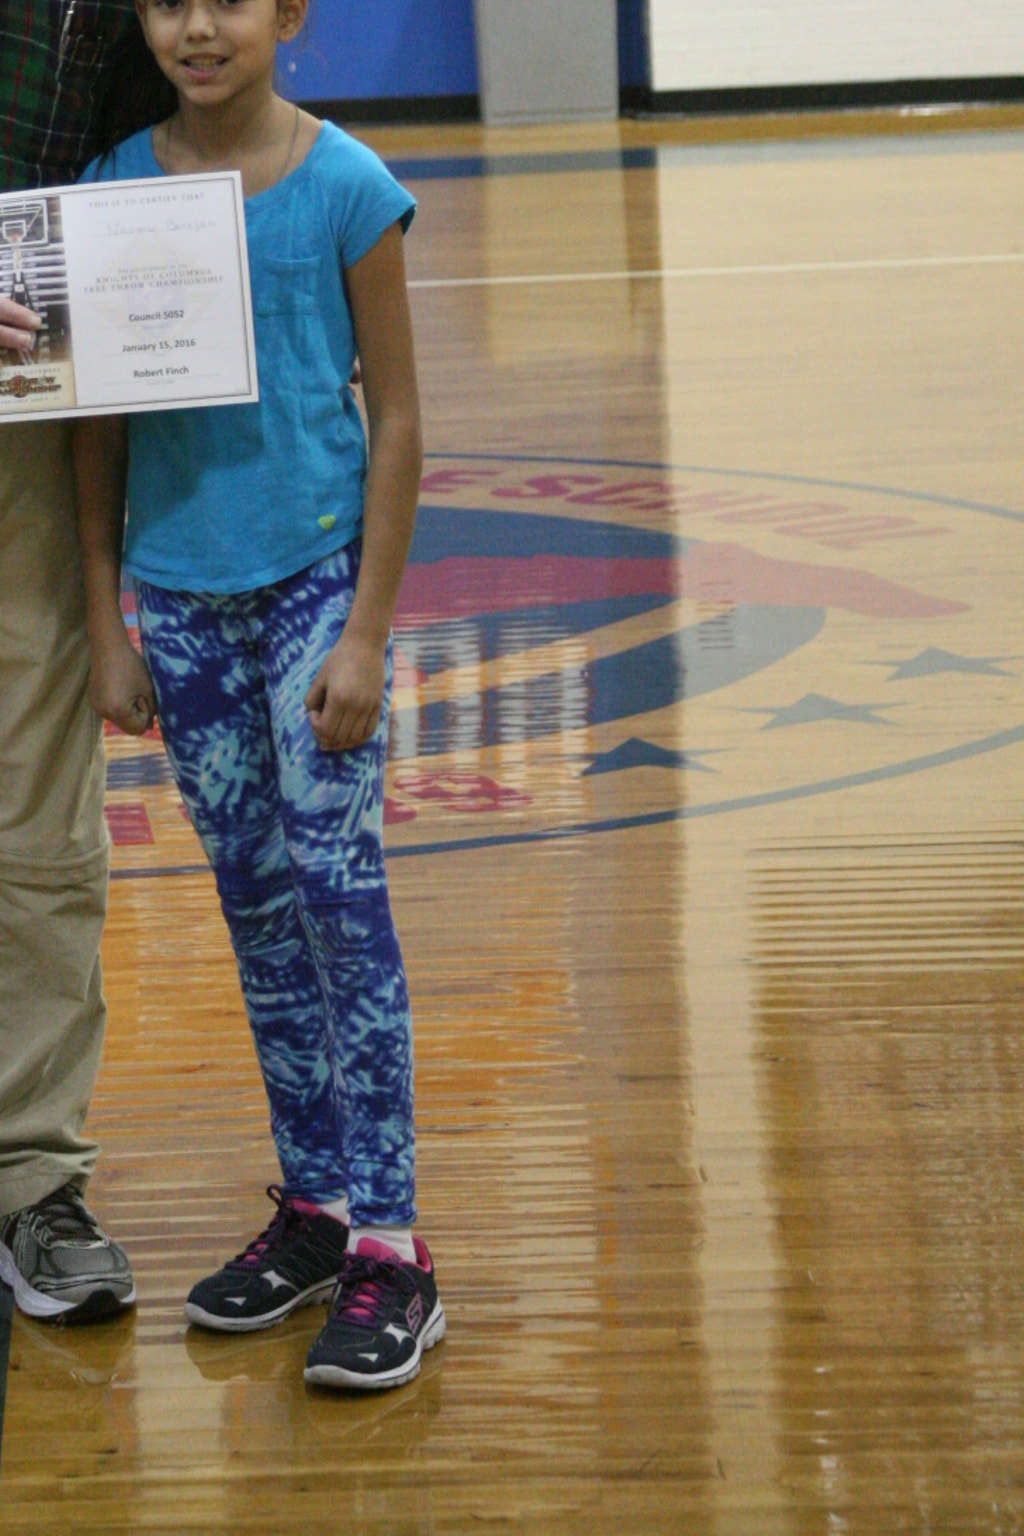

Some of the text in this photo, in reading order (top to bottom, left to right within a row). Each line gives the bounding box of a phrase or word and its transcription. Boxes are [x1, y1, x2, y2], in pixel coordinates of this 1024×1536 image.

[128, 311, 161, 322] Council
[122, 343, 157, 352] January
[174, 338, 197, 348] 2016
[133, 365, 189, 378] Robert Finch
